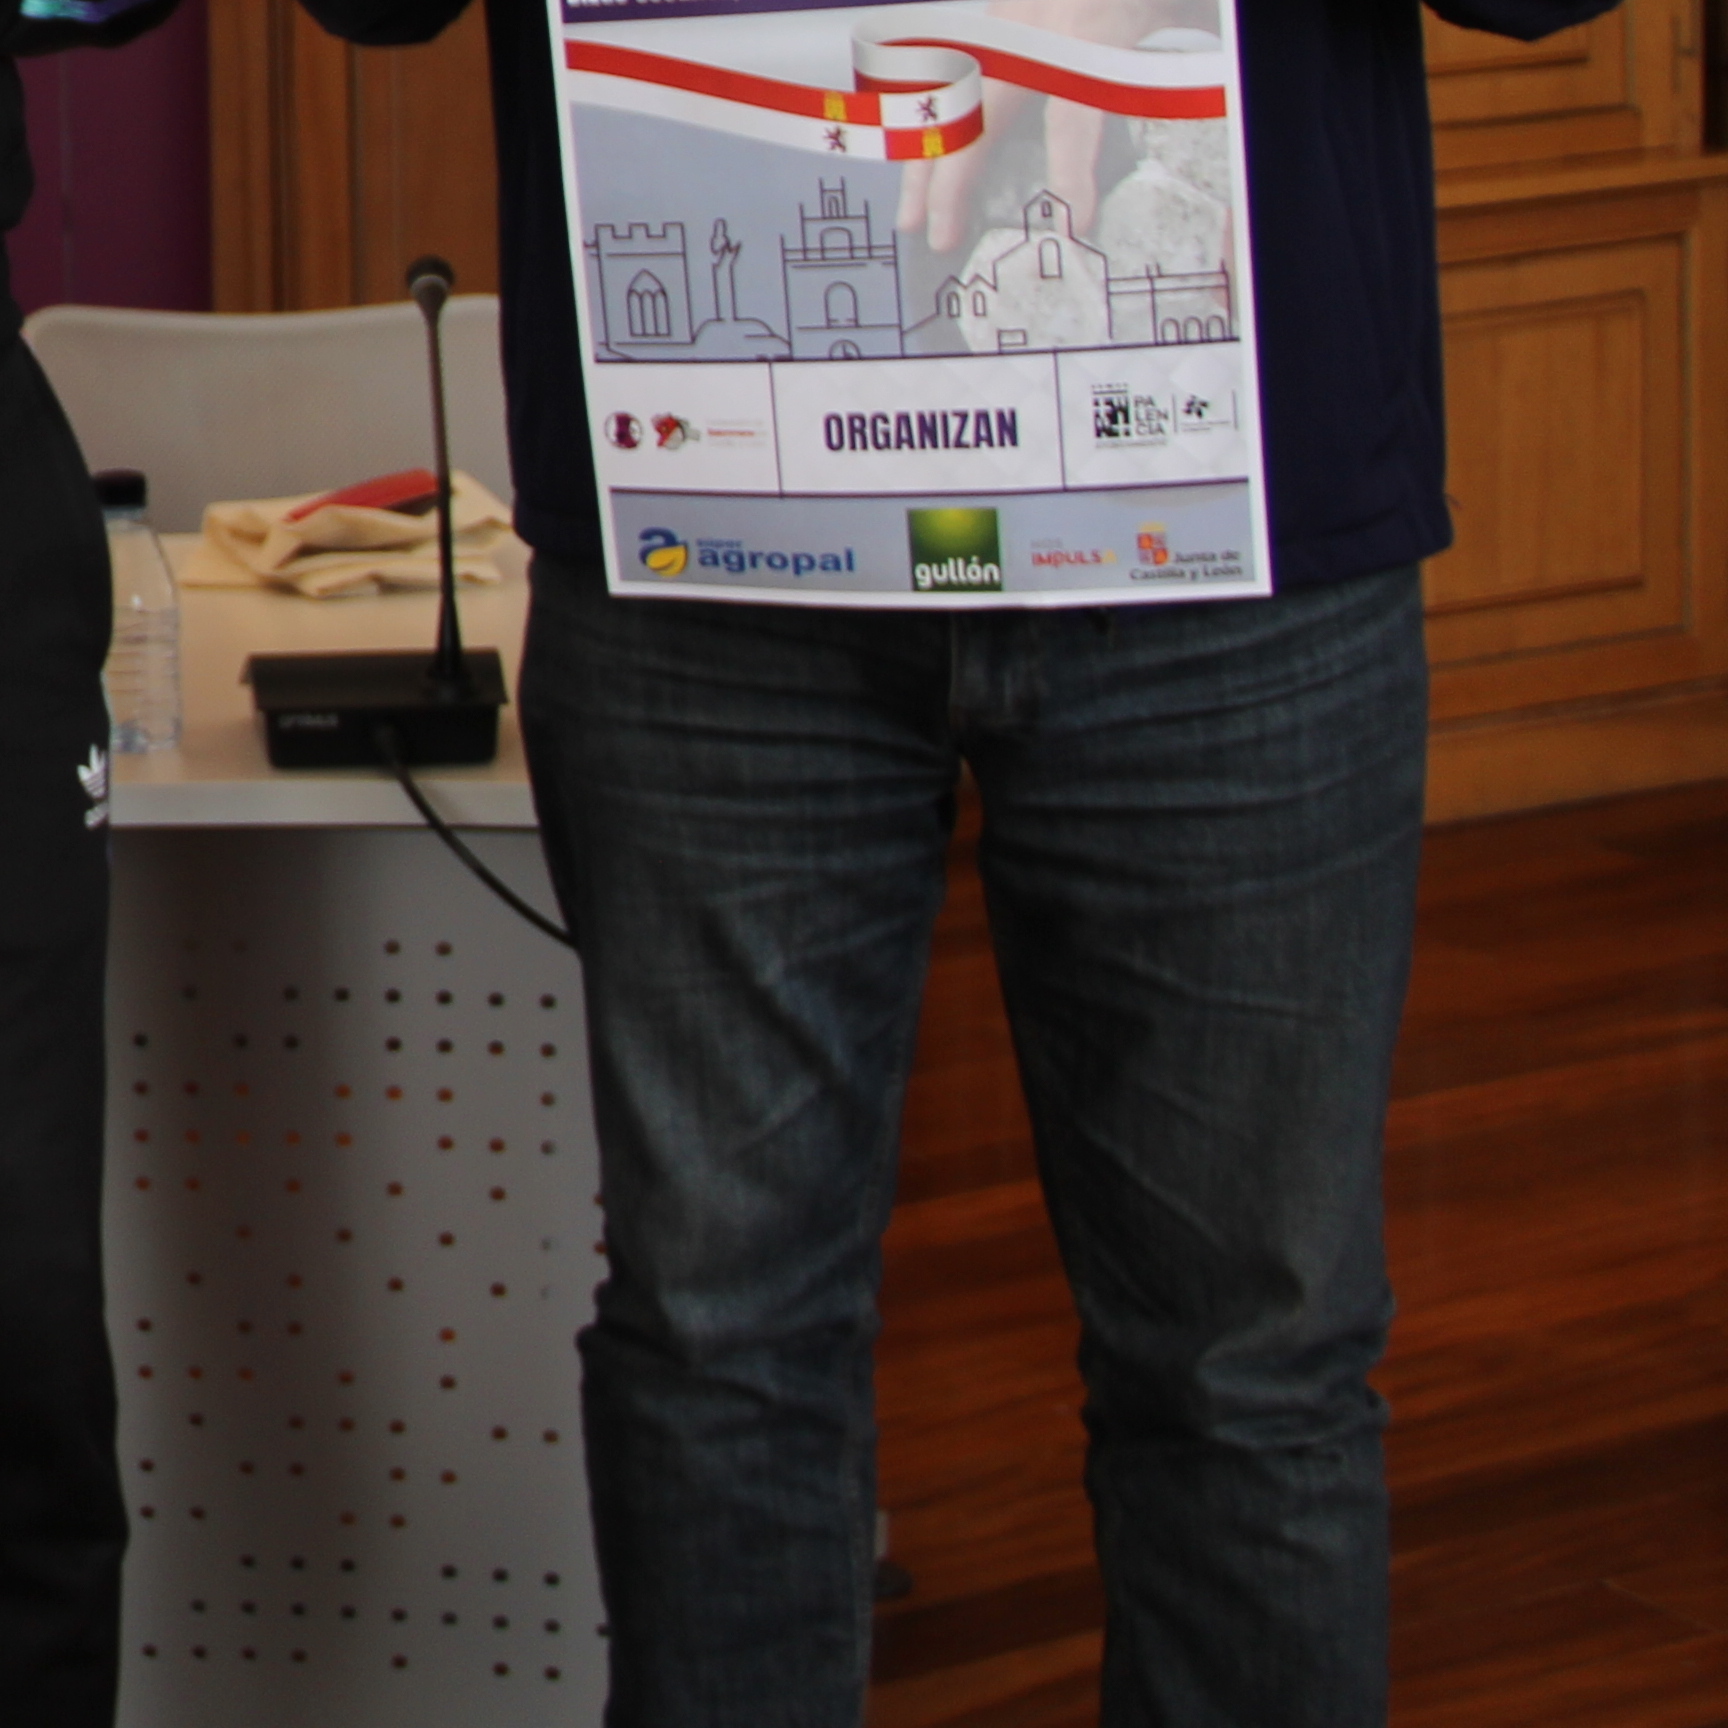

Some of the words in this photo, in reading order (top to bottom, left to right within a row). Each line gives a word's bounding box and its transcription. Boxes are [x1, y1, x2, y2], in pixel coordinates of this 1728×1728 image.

[823, 408, 1018, 451] ORGANIZAN
[697, 547, 855, 575] agropal
[915, 556, 1001, 589] gullón
